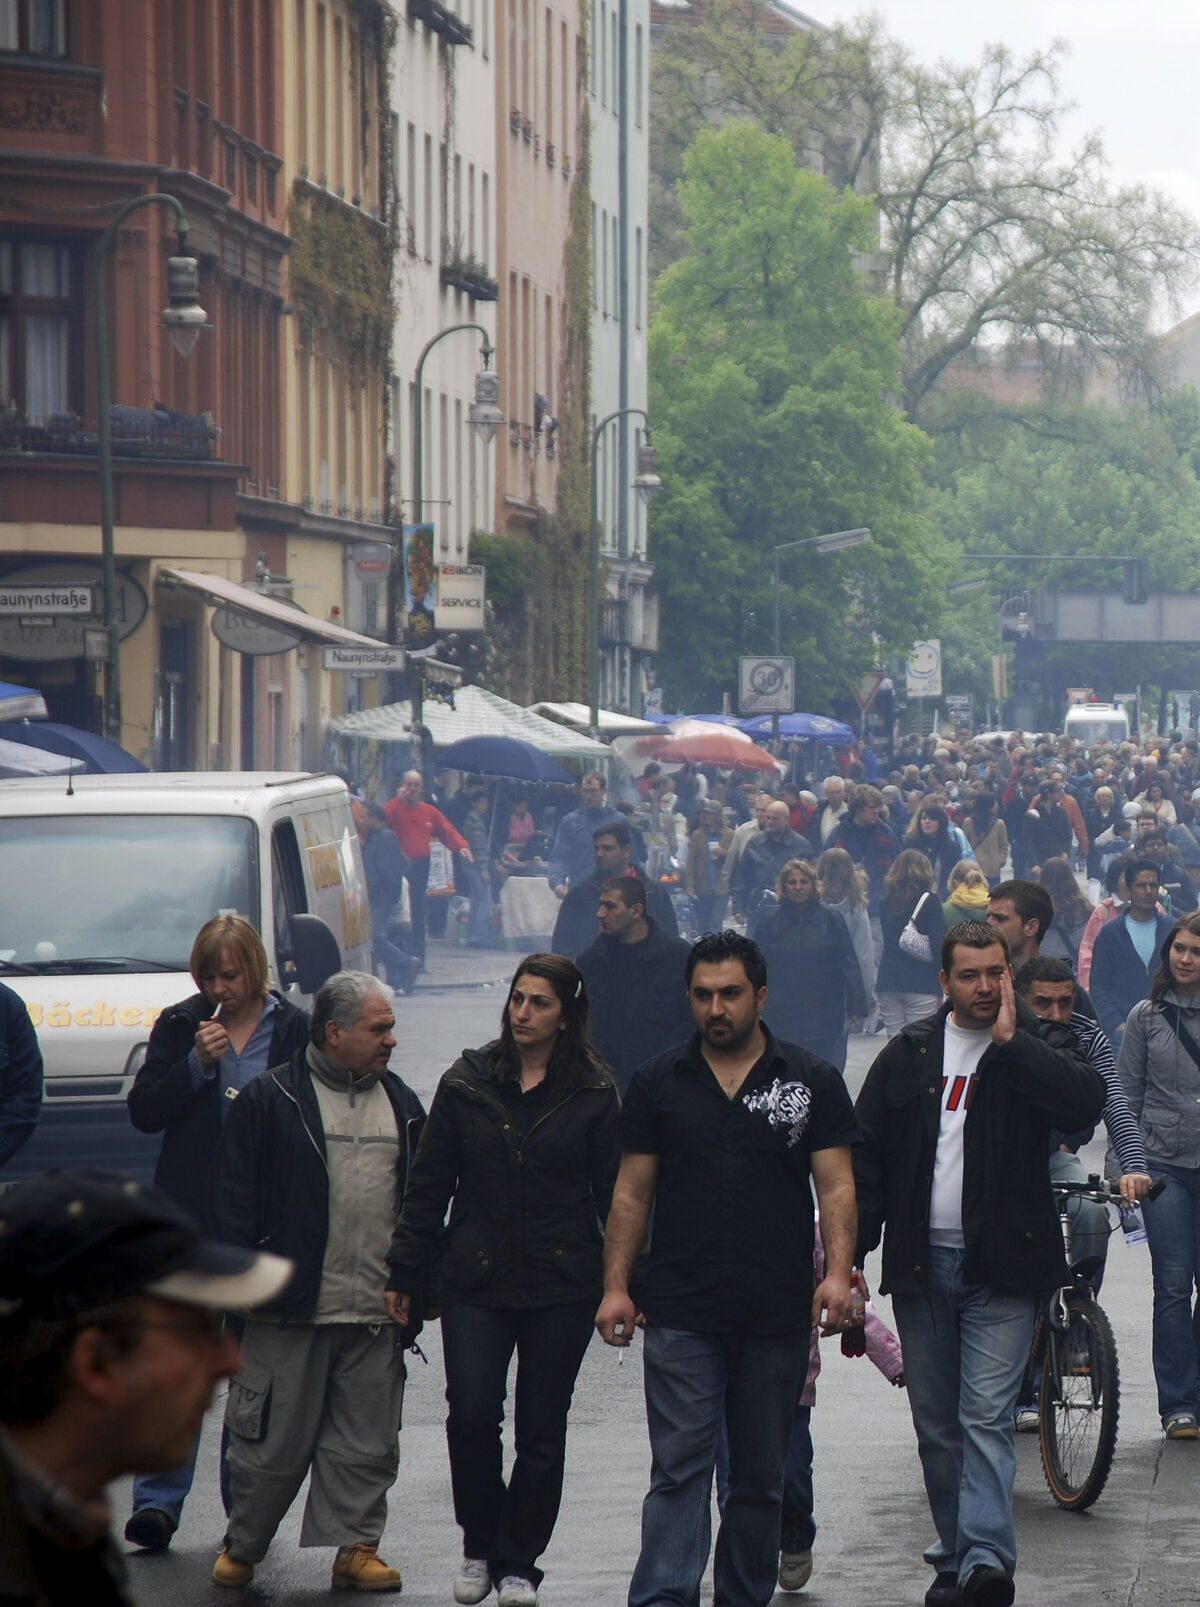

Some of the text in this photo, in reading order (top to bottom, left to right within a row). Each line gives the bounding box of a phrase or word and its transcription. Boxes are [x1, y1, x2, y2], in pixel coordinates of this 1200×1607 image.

[441, 598, 481, 608] SERVICE
[332, 650, 397, 666] Naunynstraße
[779, 1087, 810, 1118] SMG
